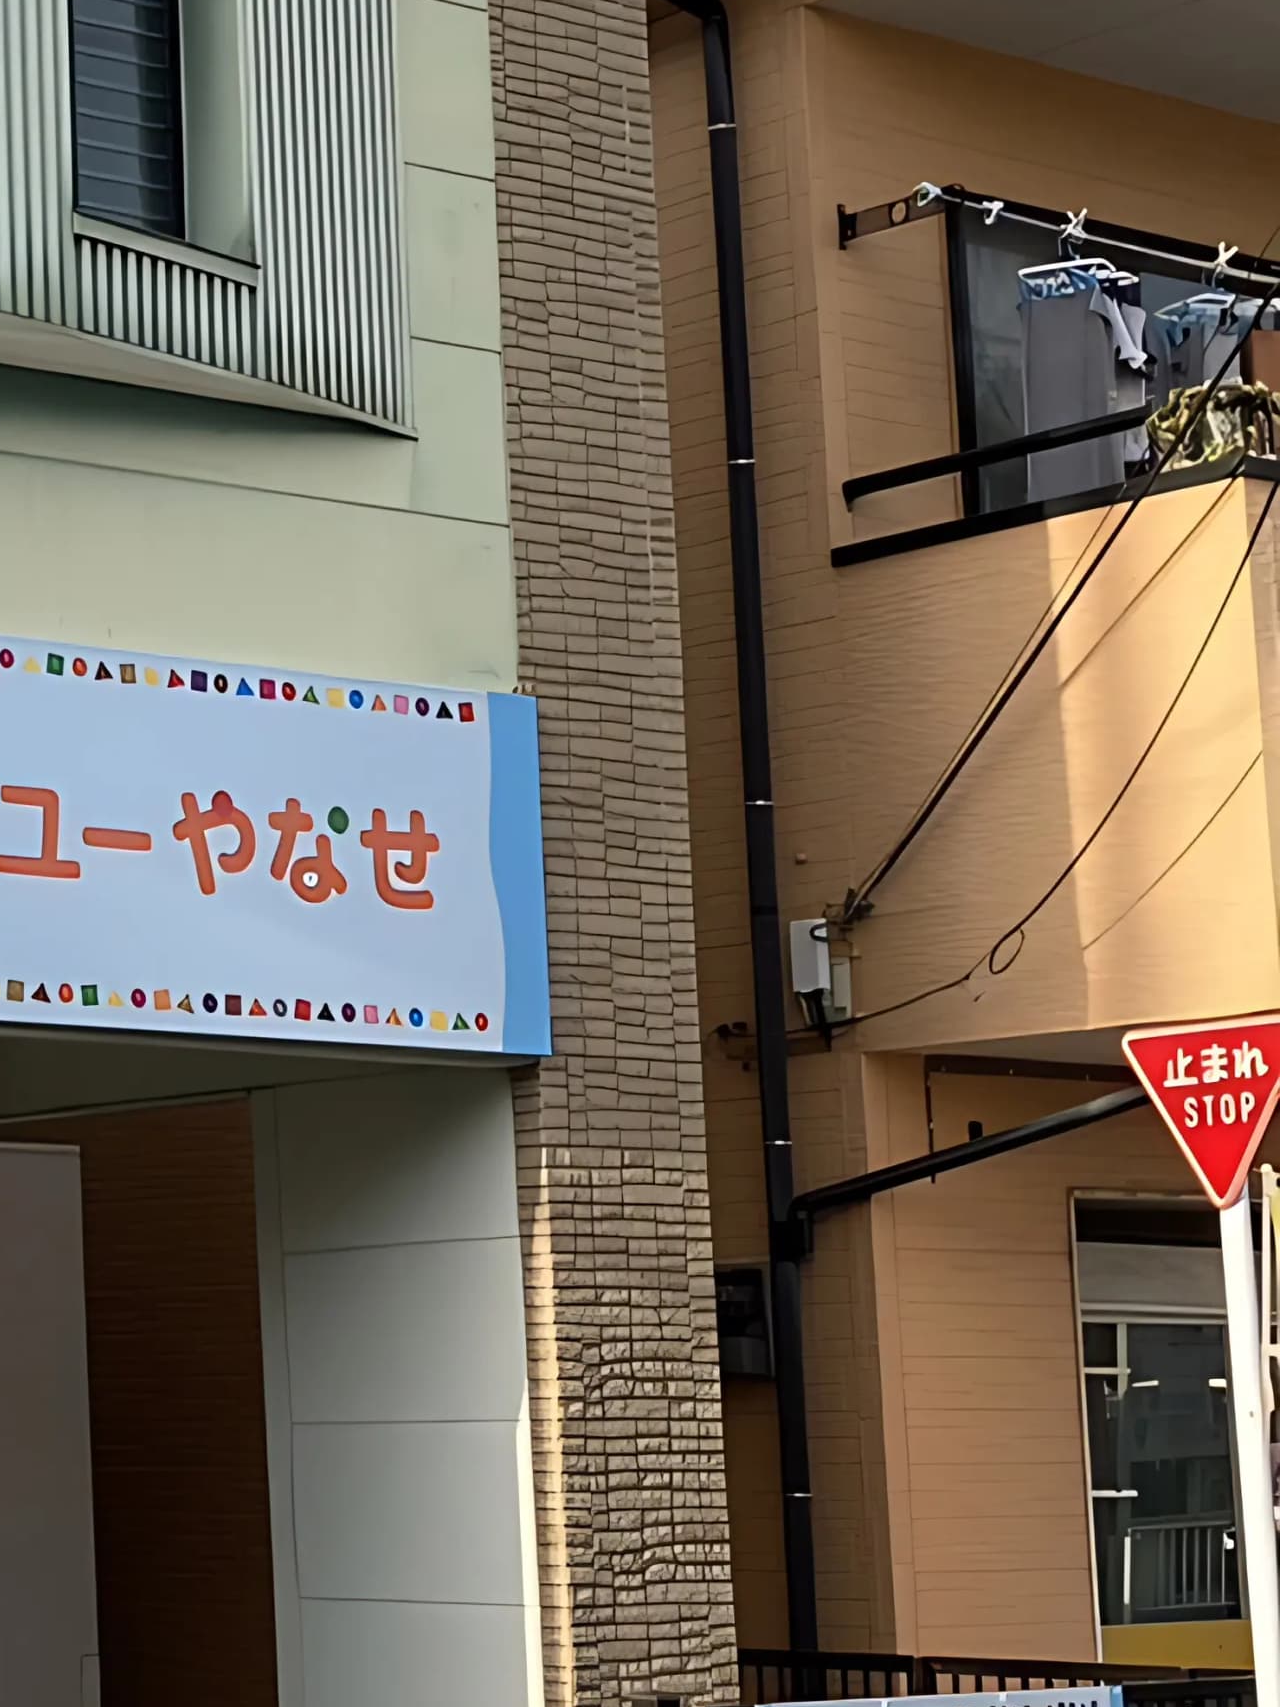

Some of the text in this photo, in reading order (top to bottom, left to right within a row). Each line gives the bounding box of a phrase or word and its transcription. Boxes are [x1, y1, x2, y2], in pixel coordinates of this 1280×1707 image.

[1162, 1040, 1270, 1089] 止まれ
[1182, 1090, 1256, 1129] STOP
